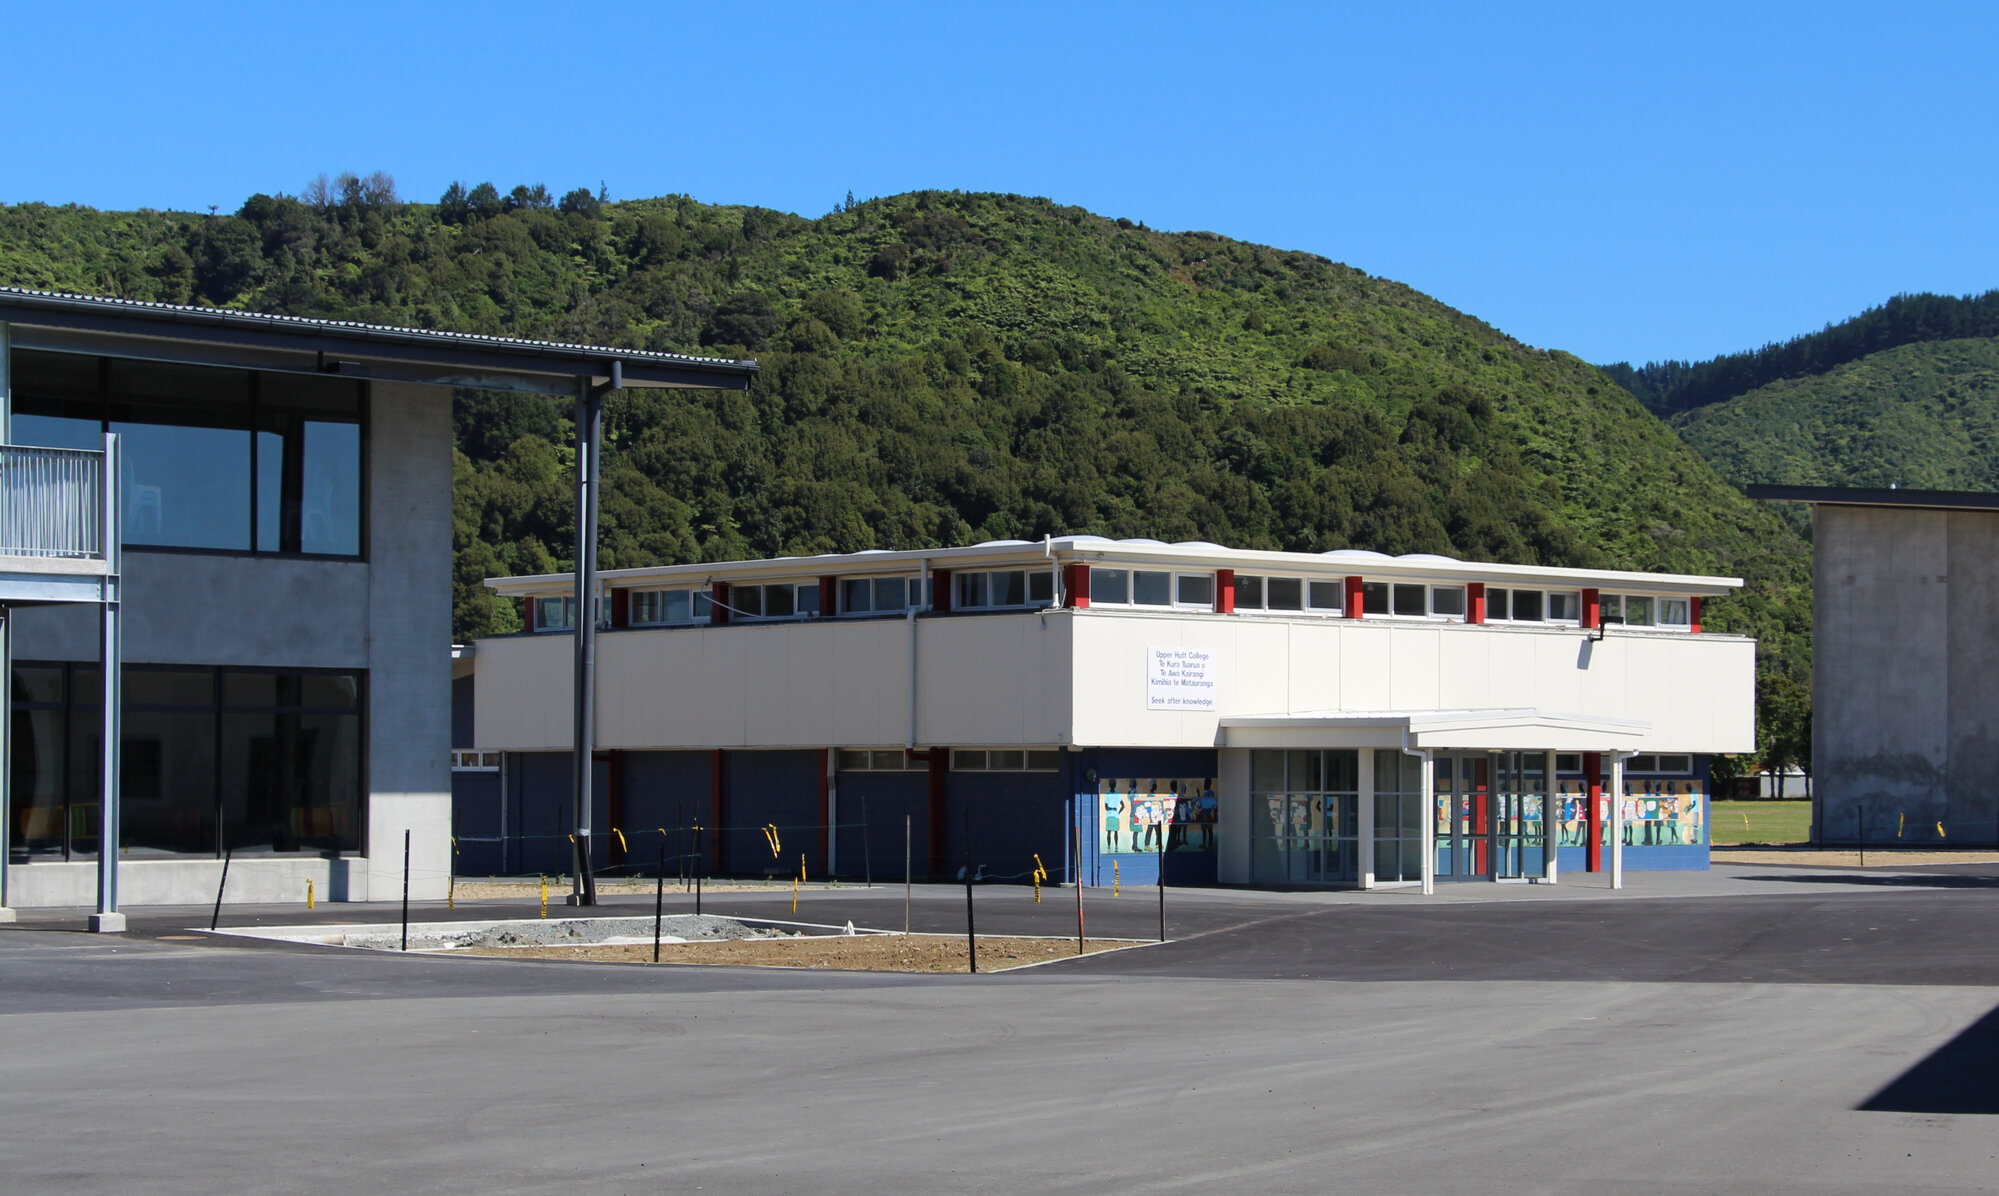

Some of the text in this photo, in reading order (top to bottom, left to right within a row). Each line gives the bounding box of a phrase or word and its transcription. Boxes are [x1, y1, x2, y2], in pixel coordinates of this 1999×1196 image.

[1156, 650, 1209, 661] Upper Hutt College
[1159, 659, 1165, 667] Te
[1166, 660, 1180, 668] Kura
[1168, 669, 1180, 677] Awa
[1181, 670, 1205, 679] Kairangi
[1181, 679, 1213, 688] Matauranga
[1182, 698, 1213, 707] knowledge
